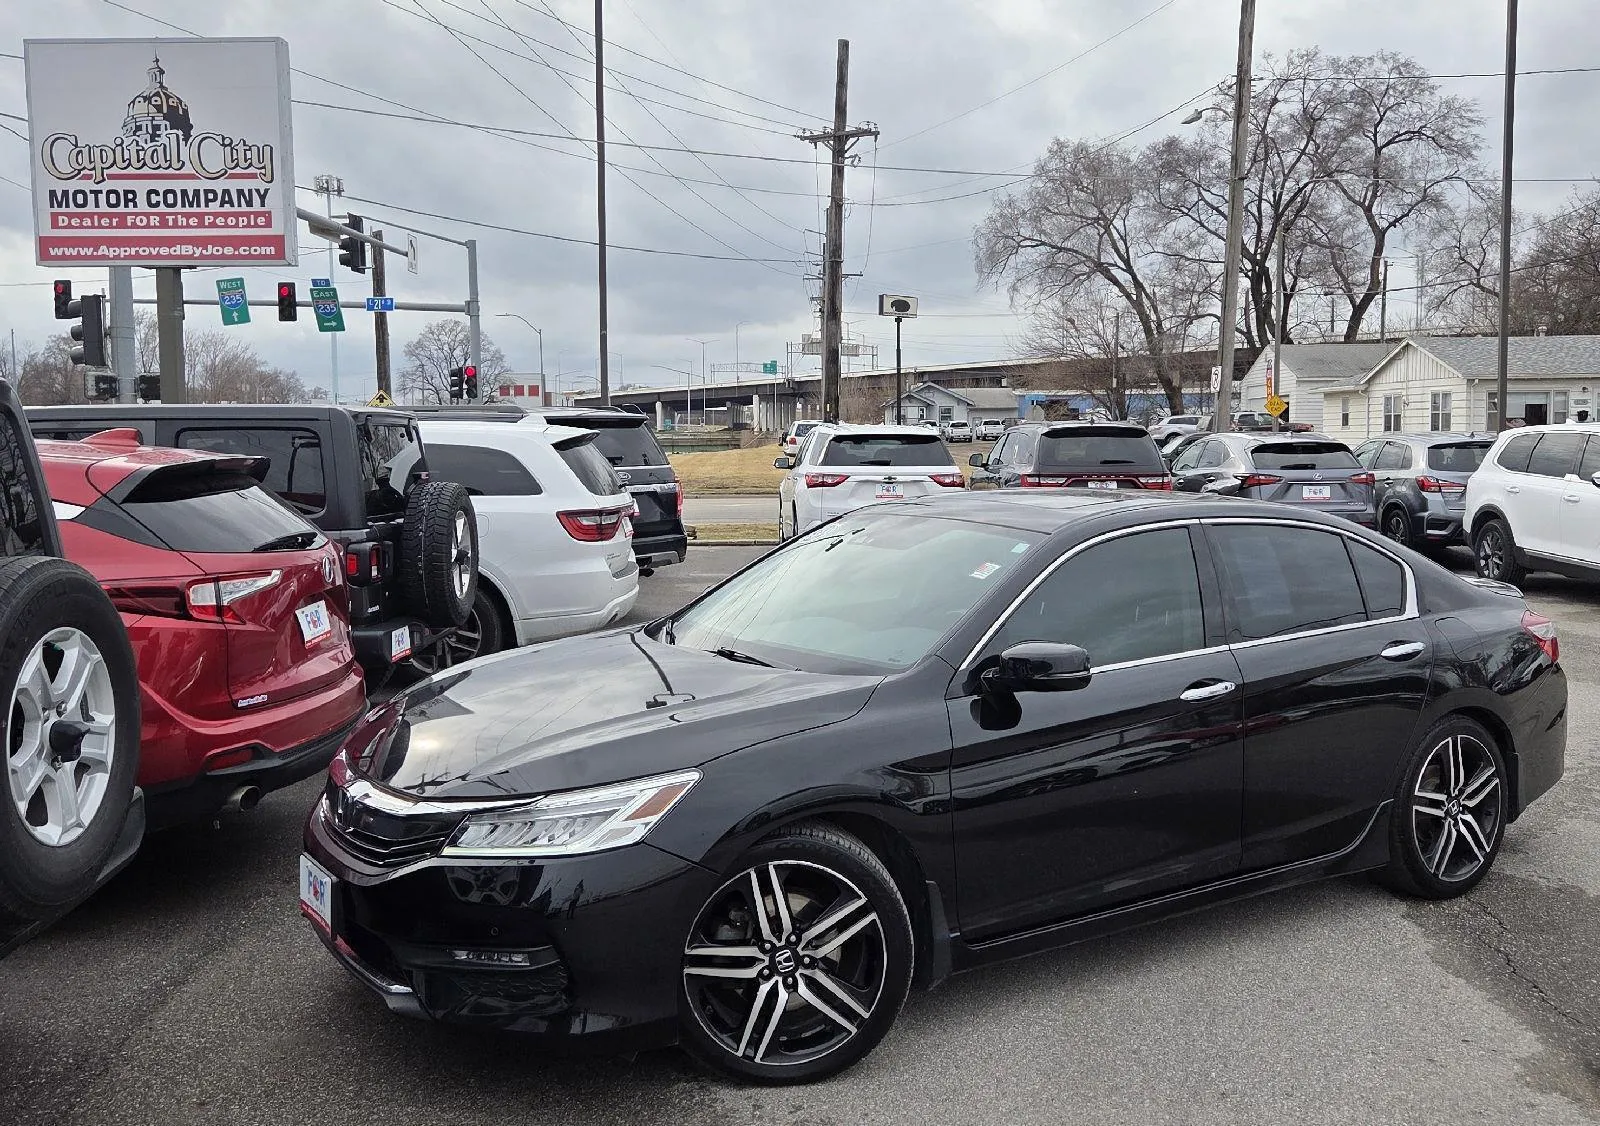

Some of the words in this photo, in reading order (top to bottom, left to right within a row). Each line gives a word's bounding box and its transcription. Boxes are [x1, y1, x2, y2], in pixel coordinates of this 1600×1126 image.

[41, 132, 185, 184] Capital
[189, 131, 275, 183] City
[48, 188, 139, 209] MOTOR
[146, 187, 271, 209] COMPANY
[57, 214, 119, 228] Dealer
[126, 214, 160, 227] FOR
[166, 214, 198, 227] The
[204, 213, 267, 229] People
[48, 243, 276, 258] www.ApprovedByJoe.com
[219, 281, 241, 289] WEST
[223, 295, 243, 305] 235
[313, 290, 334, 298] EAST
[318, 304, 337, 313] 235
